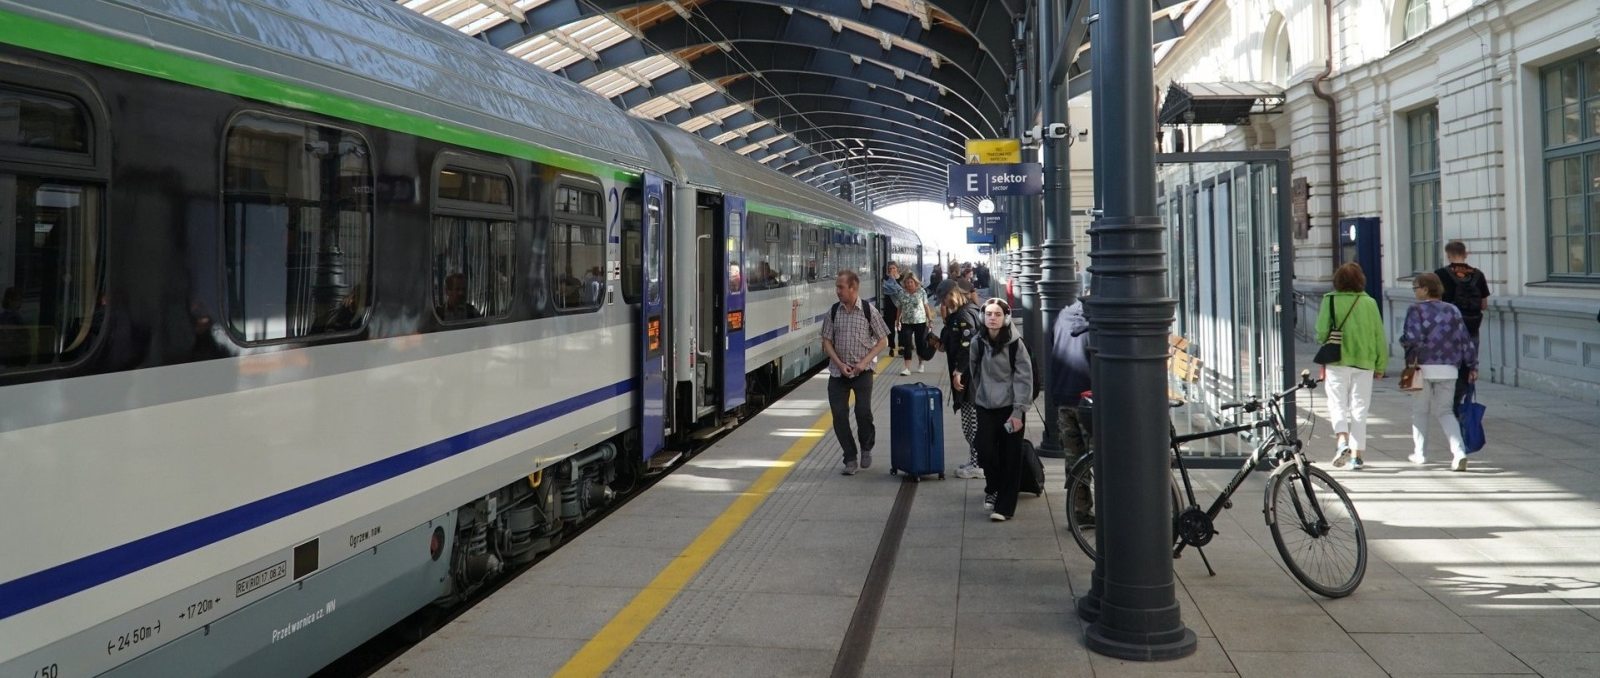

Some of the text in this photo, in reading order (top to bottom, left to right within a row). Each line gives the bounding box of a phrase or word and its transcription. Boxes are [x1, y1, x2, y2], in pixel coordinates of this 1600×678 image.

[967, 173, 979, 192] E
[991, 173, 1028, 183] sektor
[608, 186, 620, 244] 2
